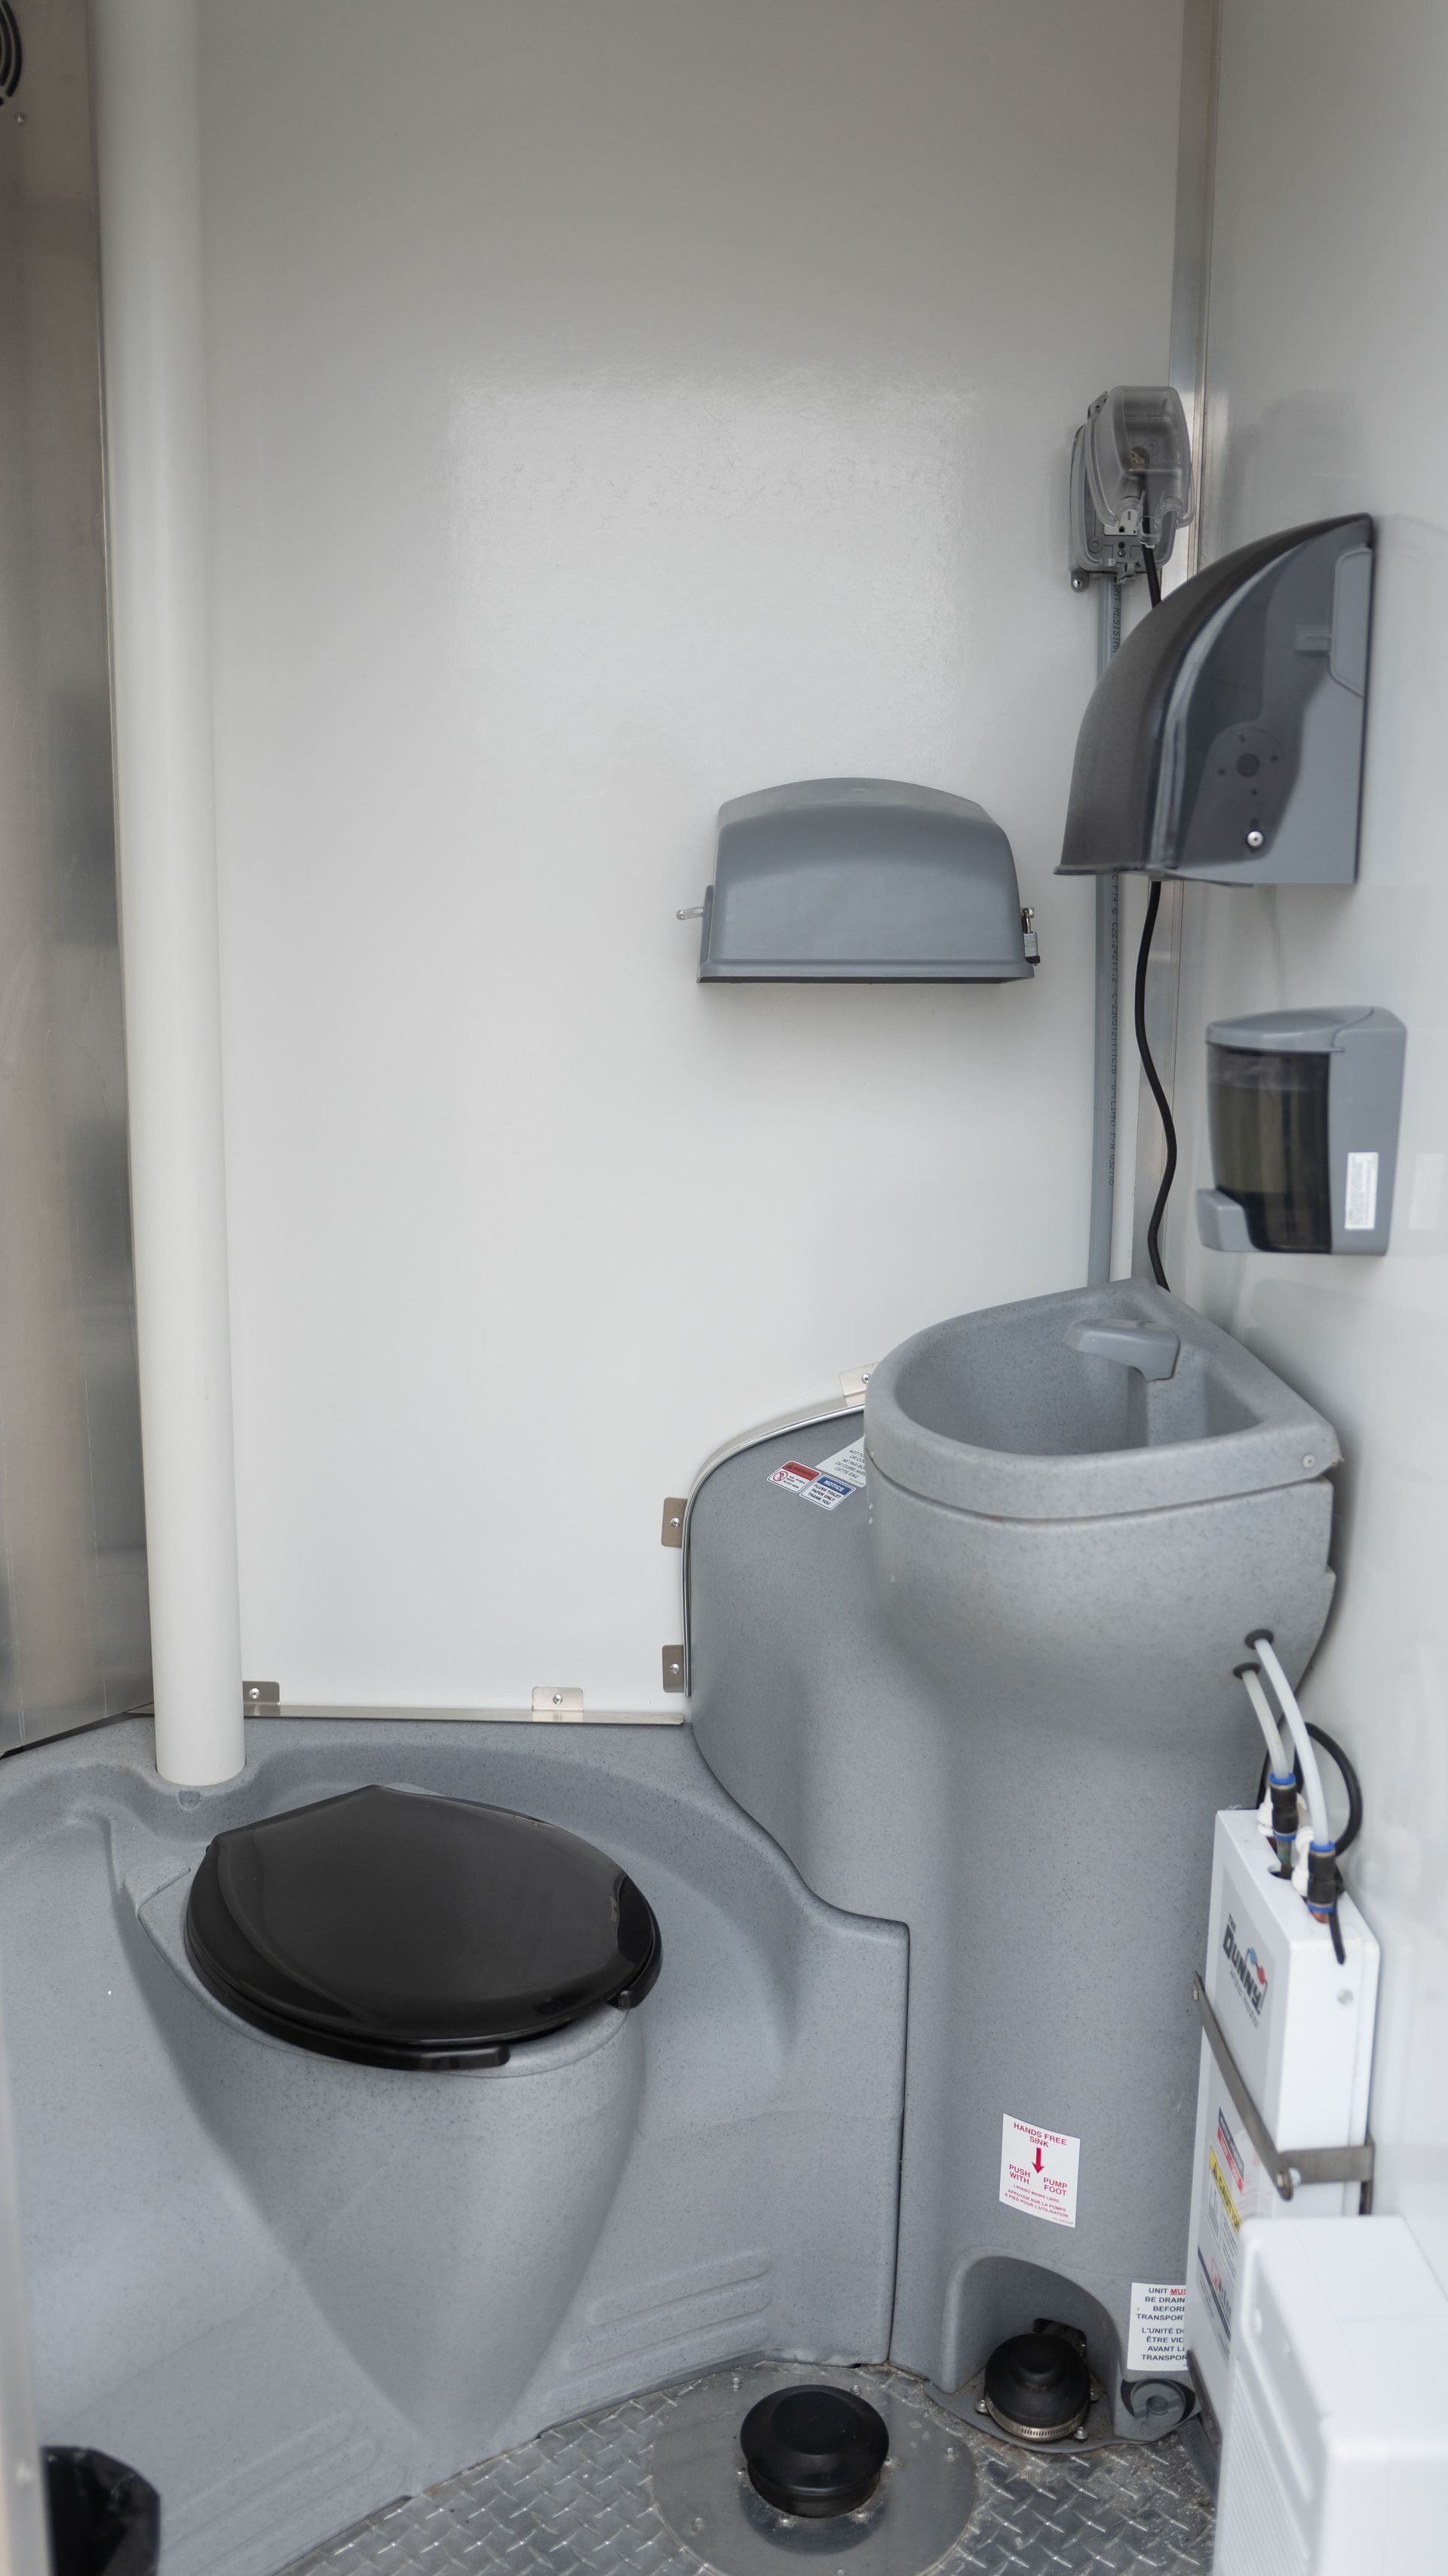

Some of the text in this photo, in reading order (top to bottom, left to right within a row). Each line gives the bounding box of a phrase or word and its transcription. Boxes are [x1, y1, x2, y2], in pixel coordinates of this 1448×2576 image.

[811, 1488, 824, 1496] PAPER
[814, 1483, 842, 1498] FLUSH TOILET
[823, 1480, 845, 1492] NOTICE
[808, 1492, 822, 1501] THANK
[1014, 2121, 1067, 2145] HANDS FREE
[1029, 2136, 1049, 2148] SINK
[1009, 2164, 1068, 2188] PUSH PUMP
[1009, 2171, 1067, 2196] WITH FOOT
[1014, 2184, 1031, 2194] LAVABO
[1031, 2191, 1045, 2199] MAINS
[1008, 2188, 1029, 2201] APPUYER
[1049, 2203, 1067, 2213] POMPE
[1008, 2194, 1020, 2203] PIED
[1020, 2199, 1034, 2207] POUR
[1034, 2203, 1069, 2219] L'UTILISATION
